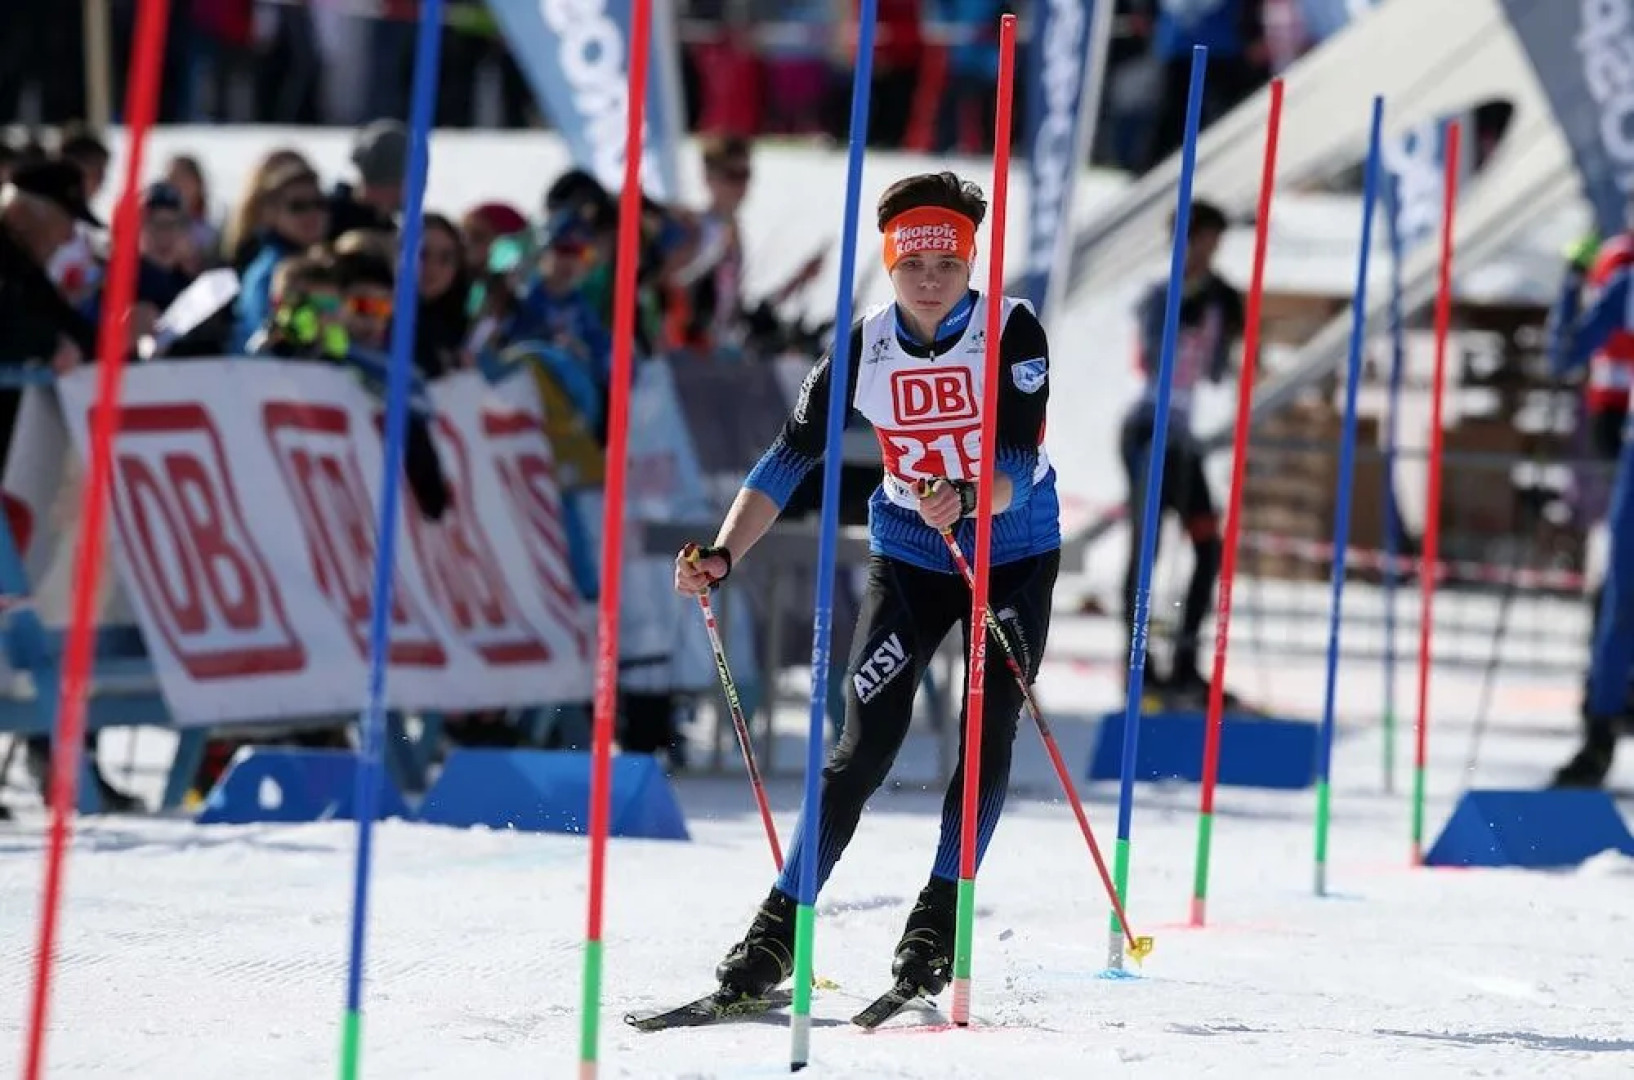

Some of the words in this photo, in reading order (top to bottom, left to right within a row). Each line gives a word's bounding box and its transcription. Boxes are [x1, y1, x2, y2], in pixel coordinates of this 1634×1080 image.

[896, 237, 958, 256] ROCKETS
[899, 224, 957, 243] NORDIC
[902, 376, 965, 416] DB
[853, 632, 905, 699] ATSV
